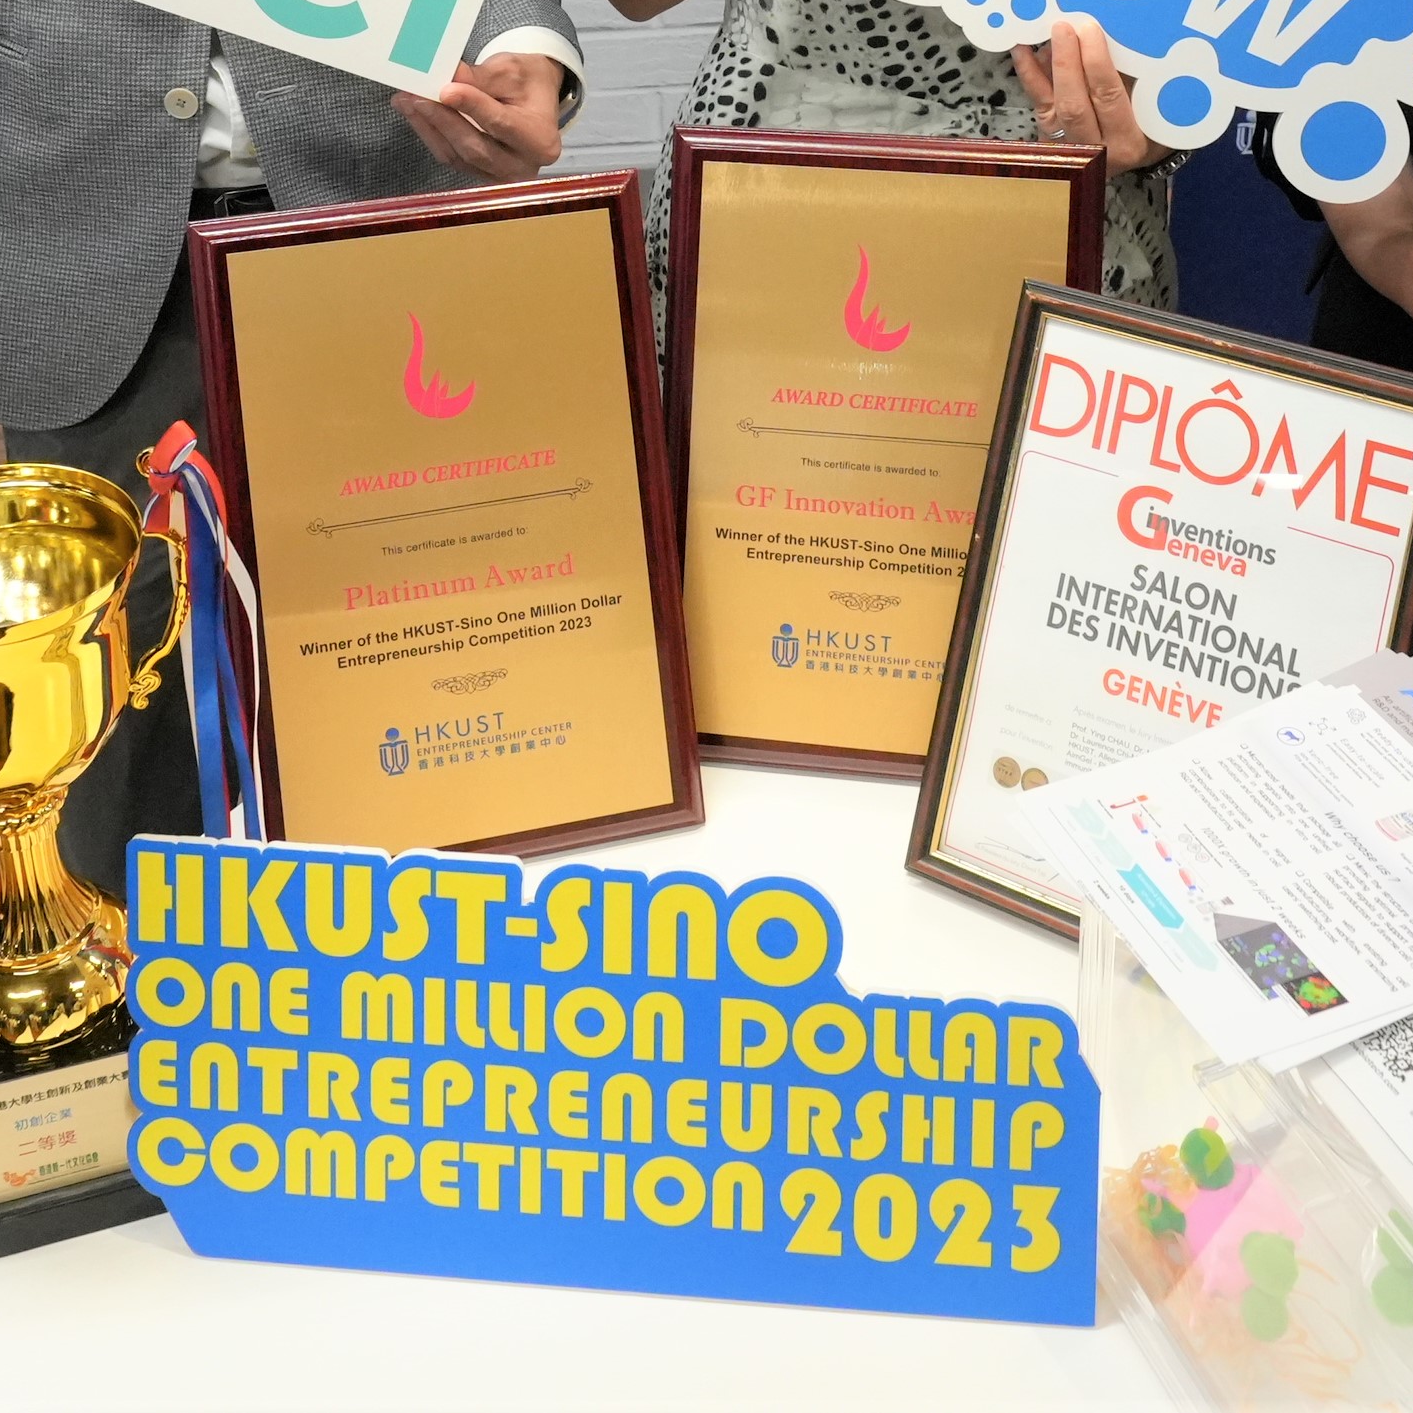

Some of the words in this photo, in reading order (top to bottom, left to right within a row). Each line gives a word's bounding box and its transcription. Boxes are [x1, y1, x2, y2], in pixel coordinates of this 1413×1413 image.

[339, 468, 417, 497] AWARD
[422, 448, 557, 485] CERTIFICATE
[736, 485, 775, 508] GF
[785, 489, 916, 521] Innovation
[923, 504, 977, 525] Awa
[1117, 485, 1247, 578] Geneva
[381, 547, 403, 555] This
[406, 539, 455, 552] certificate
[471, 528, 513, 542] awarded
[1146, 506, 1276, 566] inventions
[343, 571, 477, 611] Platinum
[485, 553, 575, 591] Award
[1130, 564, 1238, 621] SALON
[1046, 603, 1099, 643] DES
[1056, 573, 1301, 678] INTERNATIONAL
[1102, 667, 1223, 729] GENÈVE
[1324, 810, 1347, 834] Why
[1343, 827, 1378, 867] choose
[1375, 861, 1390, 878] us
[136, 849, 831, 988] HKUST-SINO
[134, 963, 309, 1034] ONE
[341, 973, 685, 1062] MILLION
[728, 1000, 1064, 1089] DOLLAR
[14, 1107, 73, 1131] 初創企業
[136, 1041, 1066, 1170] ENTREPRENEURSHIP
[19, 1130, 77, 1156] 二等獎
[134, 1116, 764, 1233] COMPETITION
[779, 1182, 1061, 1273] 2023
